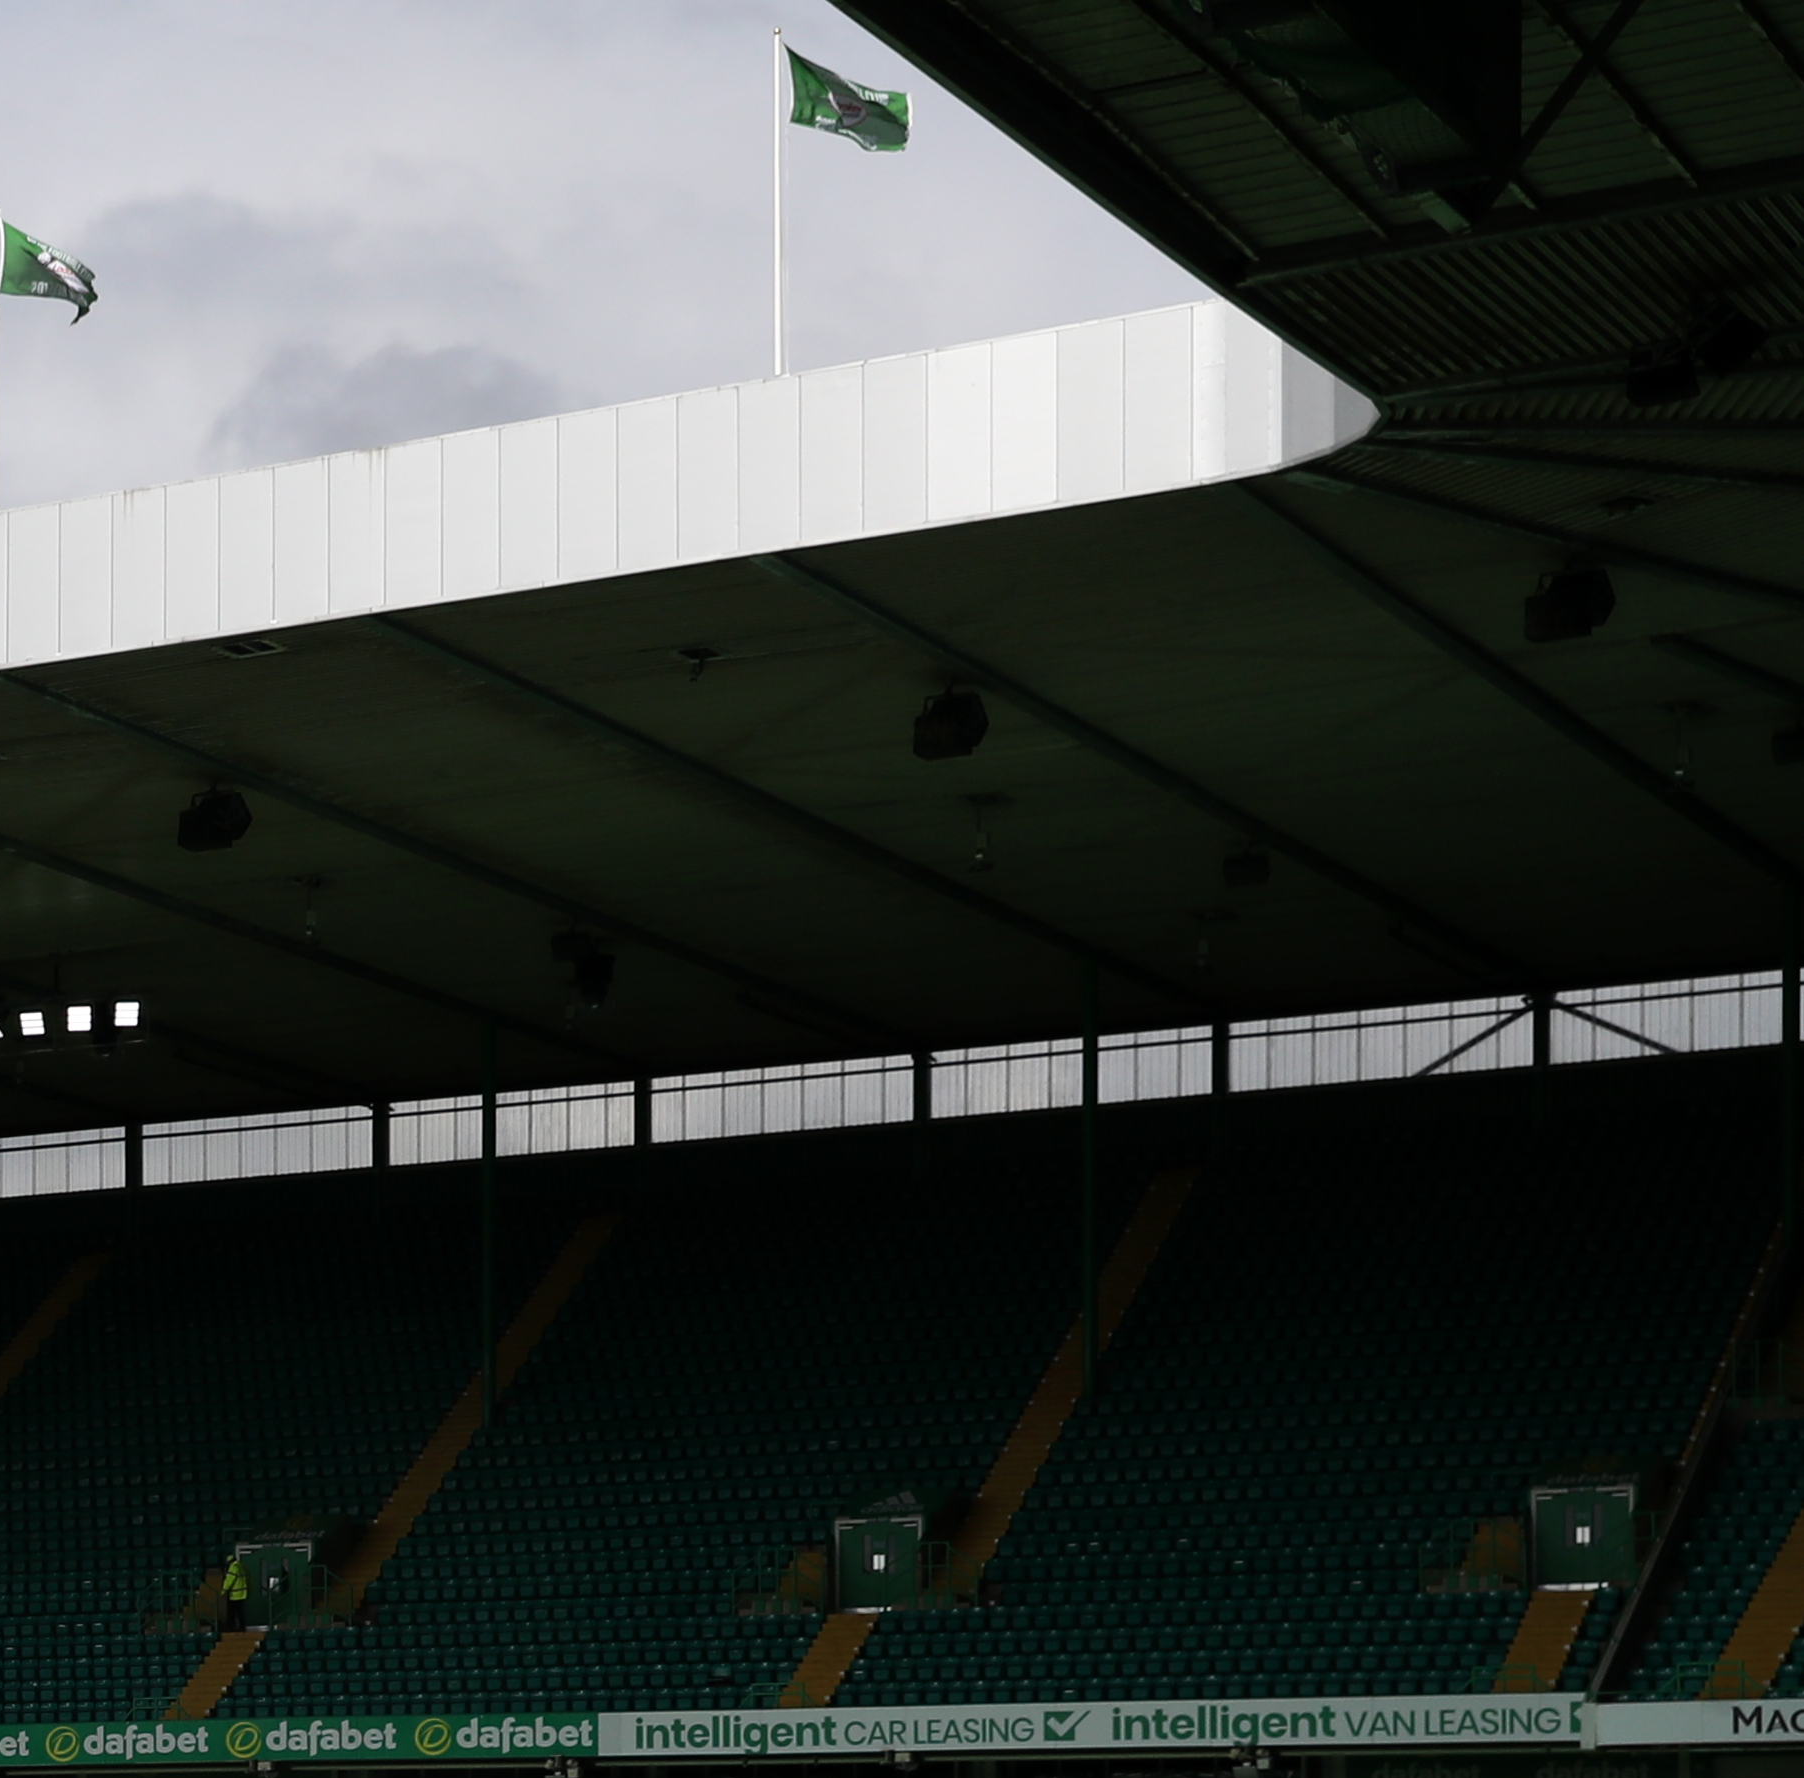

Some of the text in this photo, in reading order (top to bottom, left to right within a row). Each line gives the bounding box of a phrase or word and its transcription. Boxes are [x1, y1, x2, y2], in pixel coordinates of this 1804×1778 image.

[83, 1723, 209, 1761] dafabet
[265, 1719, 397, 1757] dafabet
[456, 1716, 593, 1755] dafabet
[635, 1715, 1035, 1755] intelligent CAR LEASING
[1112, 1704, 1562, 1747] intelligent VAN LEASING
